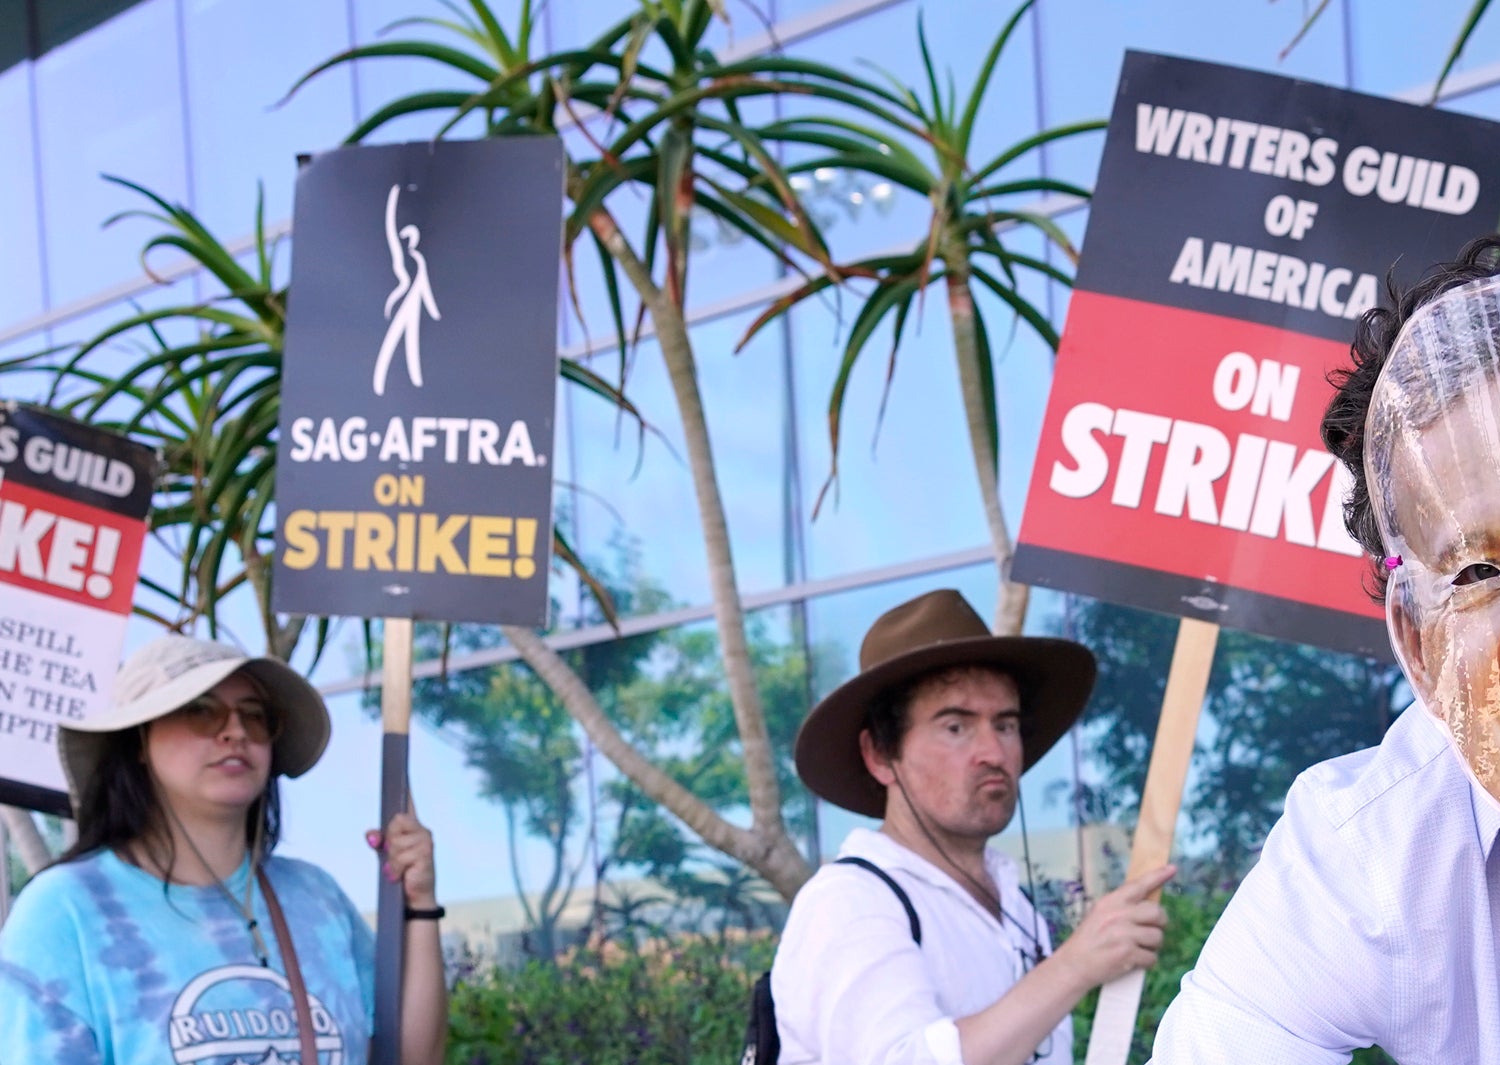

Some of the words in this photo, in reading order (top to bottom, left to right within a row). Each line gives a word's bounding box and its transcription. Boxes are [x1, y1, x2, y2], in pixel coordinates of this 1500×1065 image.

[1136, 103, 1338, 187] WRITERS
[1342, 145, 1480, 216] GUILD
[1264, 195, 1319, 240] OF
[1170, 238, 1379, 321] AMERICA
[1213, 351, 1300, 422] ON
[23, 435, 136, 498] GUILD
[373, 474, 425, 507] ON
[281, 509, 538, 579] STRIKE!
[24, 685, 87, 721] THE
[40, 659, 97, 694] TEA
[175, 1007, 331, 1047] RUIDOO
